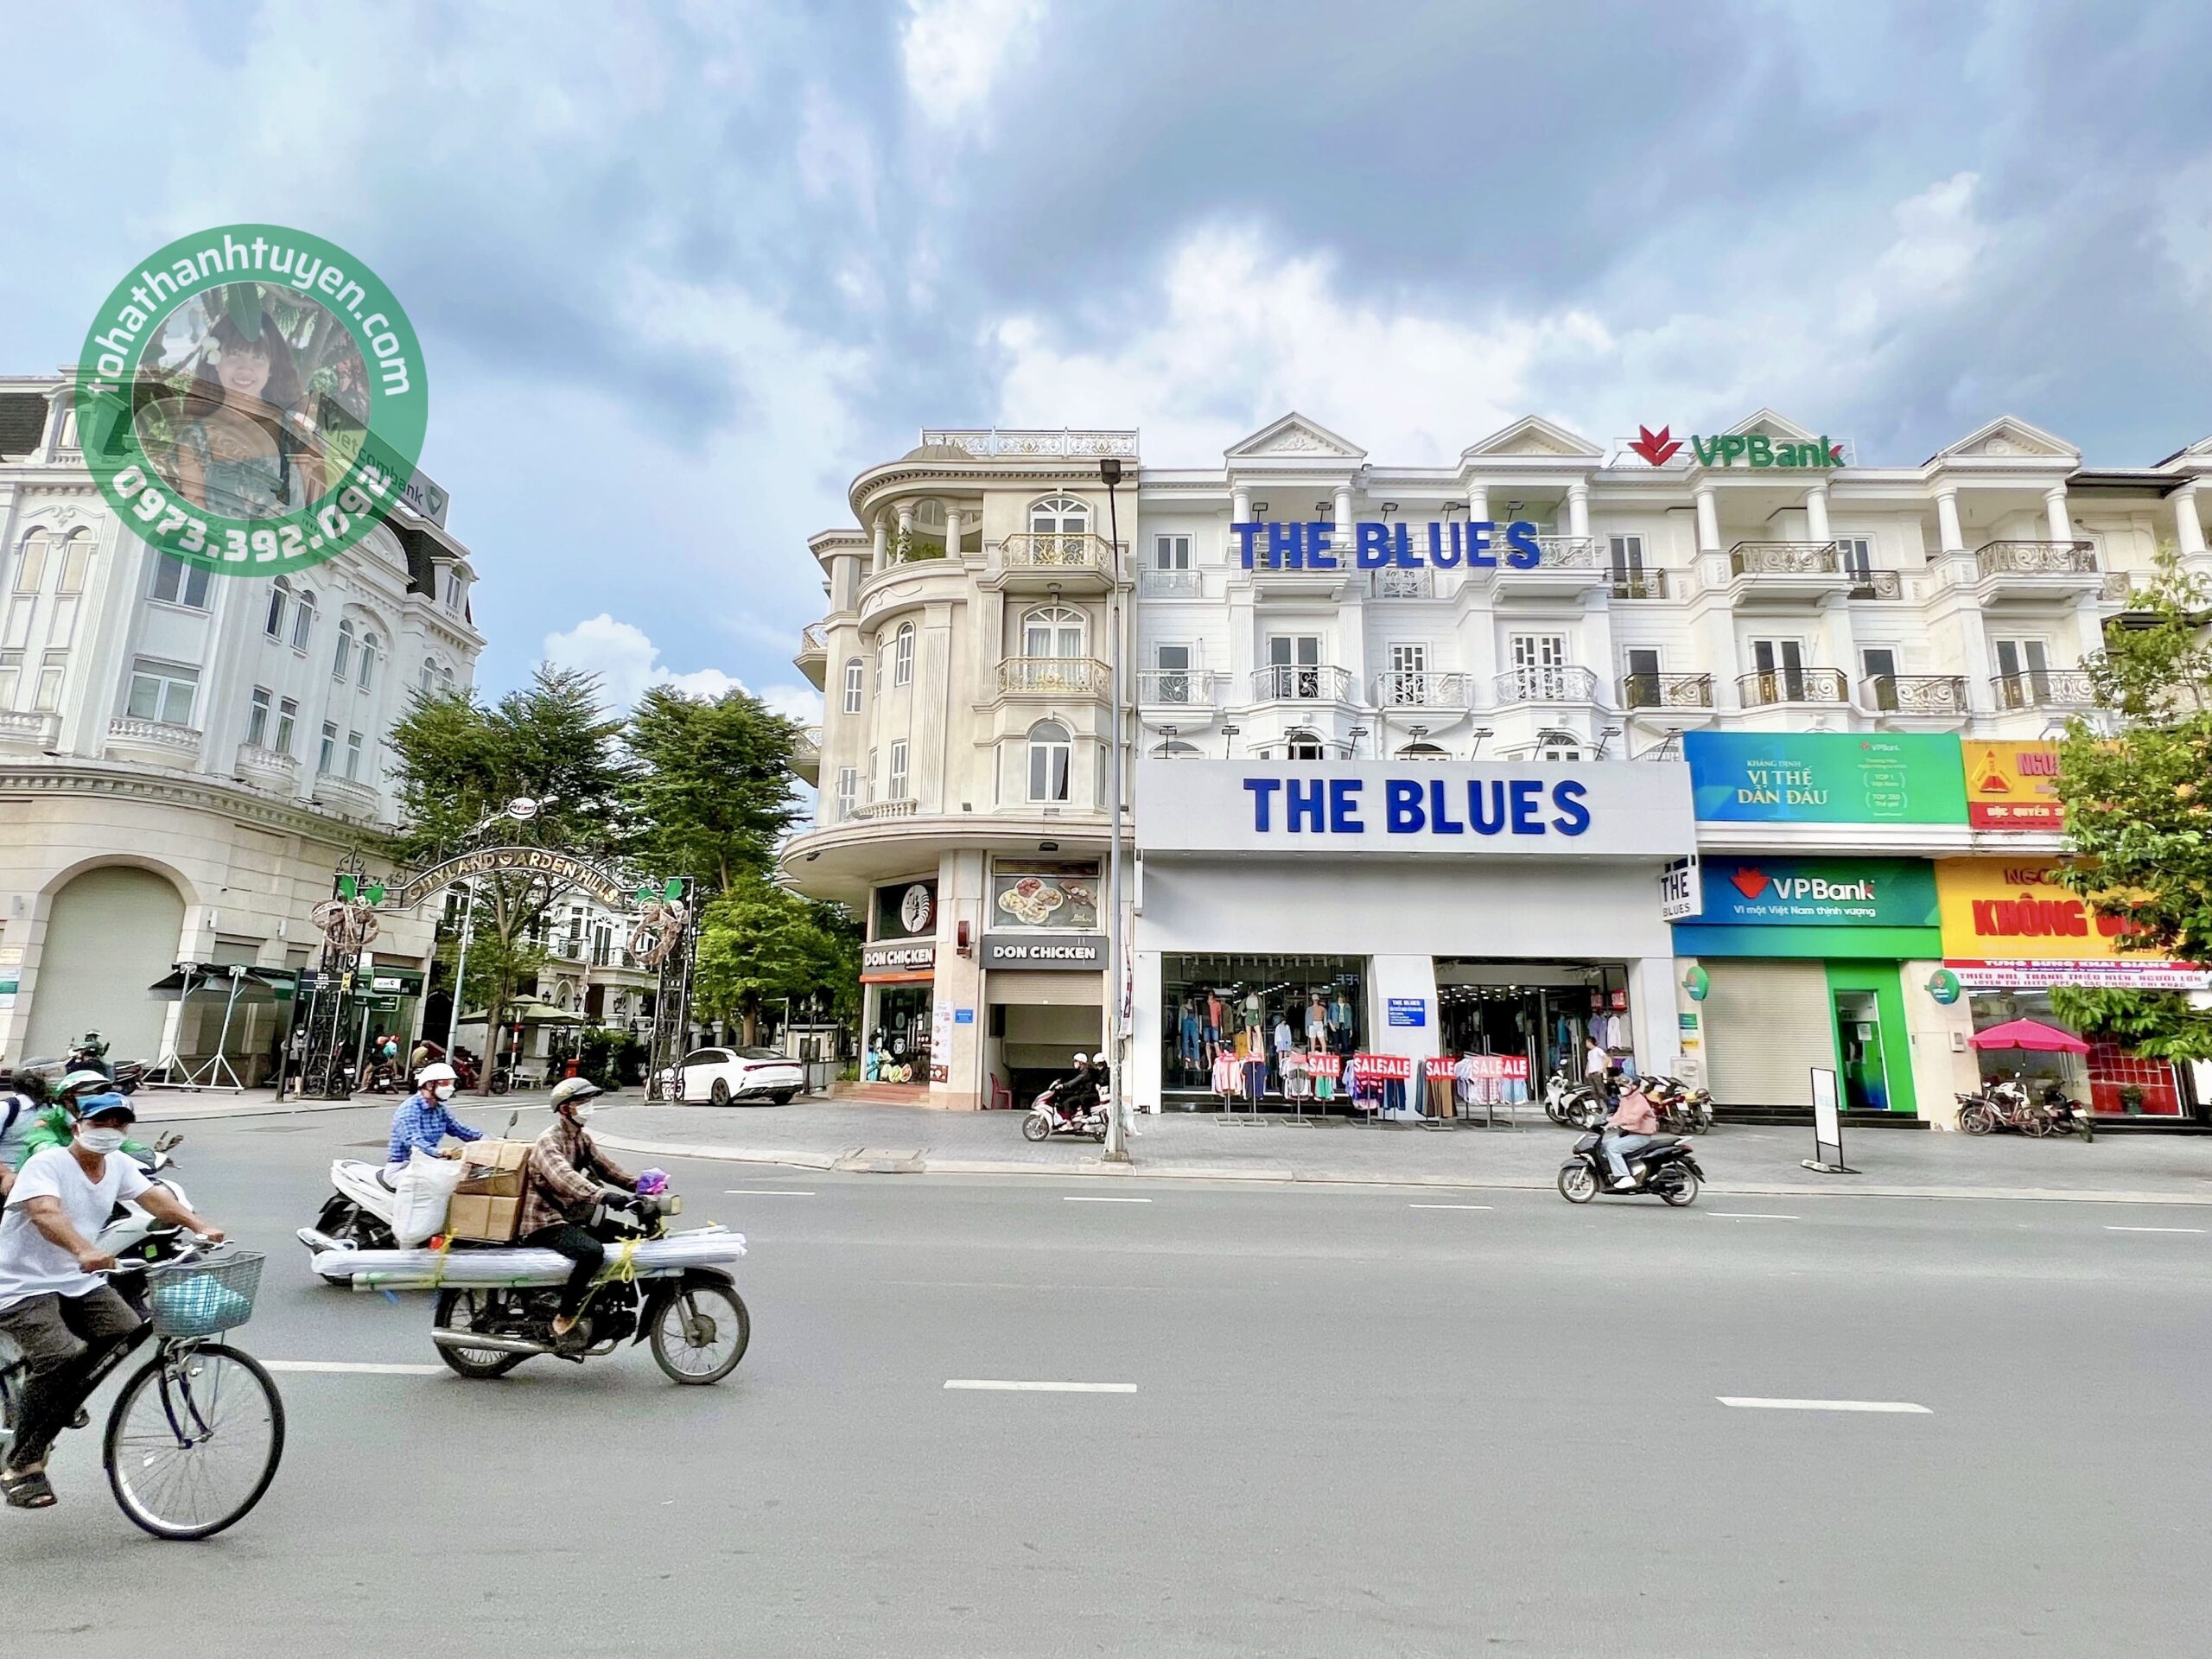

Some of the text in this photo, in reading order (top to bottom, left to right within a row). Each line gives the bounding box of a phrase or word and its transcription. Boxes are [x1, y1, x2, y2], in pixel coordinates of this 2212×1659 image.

[1691, 435, 1846, 467] VPBank
[1230, 521, 1541, 569] THE BLUES
[2017, 752, 2061, 776] NGO
[1746, 765, 1813, 788] VỊ THẾ
[1737, 784, 1828, 804] DẪN ĐẦU
[1243, 778, 1591, 836] THE BLUES
[498, 851, 578, 878] GARDEN
[577, 868, 620, 903] HILLS
[1660, 871, 1690, 902] THE
[1772, 878, 1876, 901] VPBank
[1662, 902, 1691, 917] BLUES
[1791, 906, 1815, 915] Nam
[1972, 893, 2088, 937] KHÔNG
[864, 948, 933, 967] DON CHICKEN
[993, 946, 1096, 959] DON CHICKEN
[1308, 1056, 1339, 1074] SALE
[1353, 1056, 1384, 1073] SALE
[1425, 1059, 1455, 1077] SALE
[1472, 1058, 1527, 1076] SALE ALE
